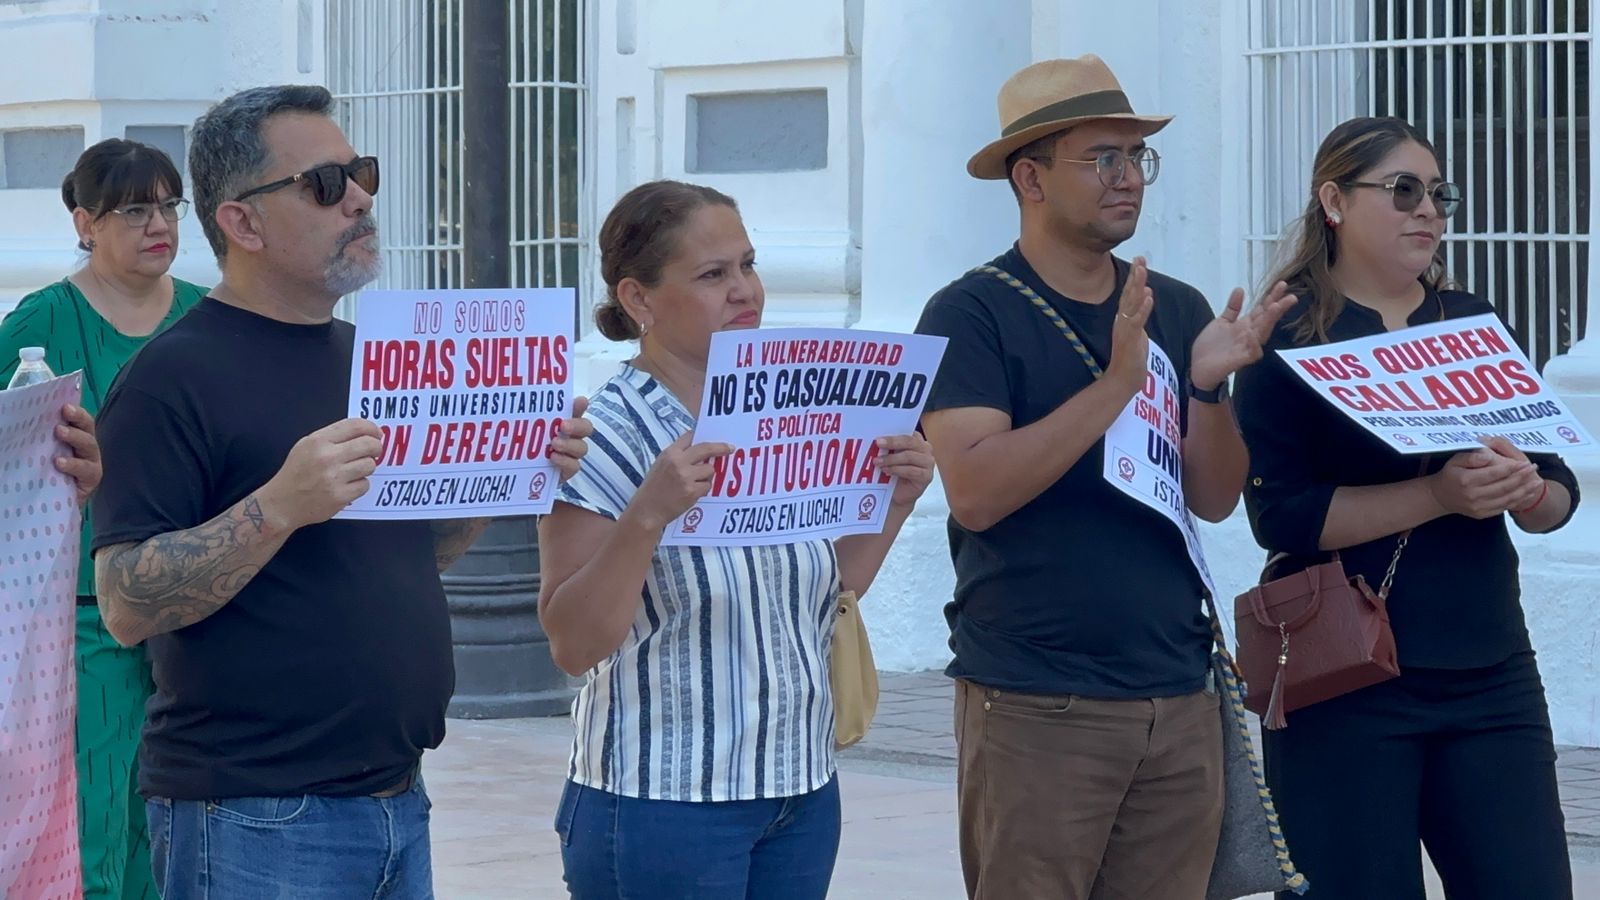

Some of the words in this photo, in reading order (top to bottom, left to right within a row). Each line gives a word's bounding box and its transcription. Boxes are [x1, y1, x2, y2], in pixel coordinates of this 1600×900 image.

[414, 301, 443, 334] NO
[454, 299, 525, 333] SOMOS
[361, 338, 456, 391] HORAS
[465, 335, 568, 388] SUELTAS
[736, 342, 753, 368] LA
[761, 339, 904, 367] VULNERABILIDAD
[1296, 353, 1371, 382] NOS
[1372, 326, 1511, 375] QUIEREN
[707, 373, 738, 417] NO
[742, 370, 768, 413] ES
[773, 367, 927, 410] CASUALIDAD
[1140, 371, 1156, 401] O
[1328, 359, 1541, 413] CALLADOS
[360, 395, 420, 420] SOMOS
[429, 389, 565, 417] UNIVERSITARIOS
[1135, 396, 1161, 431] ¡SIN
[1361, 416, 1402, 428] PERO
[1400, 415, 1465, 427] ESTAMOS
[1461, 400, 1561, 427] ORGANIZADOS
[375, 424, 412, 467] ON
[420, 417, 563, 465] DERECHOS
[757, 417, 774, 441] ES
[777, 409, 842, 439] POLÍTICA
[703, 438, 894, 498] NSTITUCIONA
[1147, 428, 1181, 484] UNI
[375, 478, 436, 507] ¡STAUS
[434, 476, 460, 505] EN
[458, 474, 517, 504] LUCHA!
[719, 503, 777, 534] ¡STAUS
[777, 499, 797, 531] EN
[798, 496, 845, 528] LUCHA!
